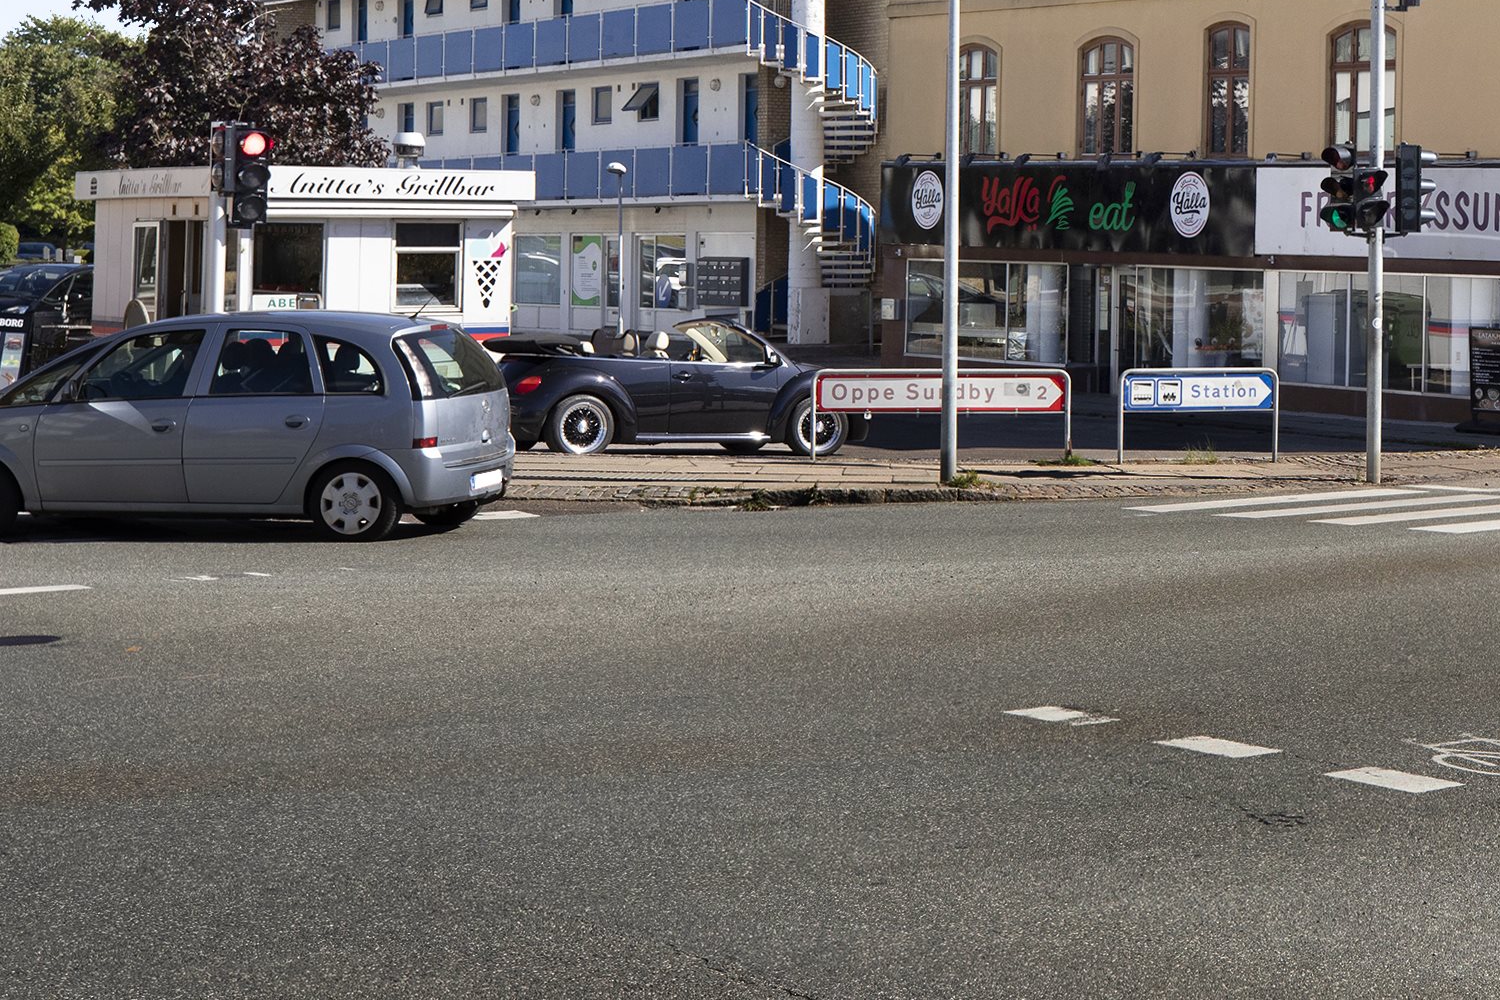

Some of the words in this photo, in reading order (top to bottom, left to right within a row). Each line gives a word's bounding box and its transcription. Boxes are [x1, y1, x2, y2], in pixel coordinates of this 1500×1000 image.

[270, 172, 385, 196] Anitta's
[396, 174, 495, 197] Grillbar
[913, 188, 942, 210] Yalla
[1088, 180, 1137, 232] eat
[1172, 191, 1208, 215] Yalla
[831, 383, 895, 403] Oppe
[906, 383, 995, 402] Sudby
[1037, 386, 1048, 400] 2
[1191, 384, 1257, 399] Station
